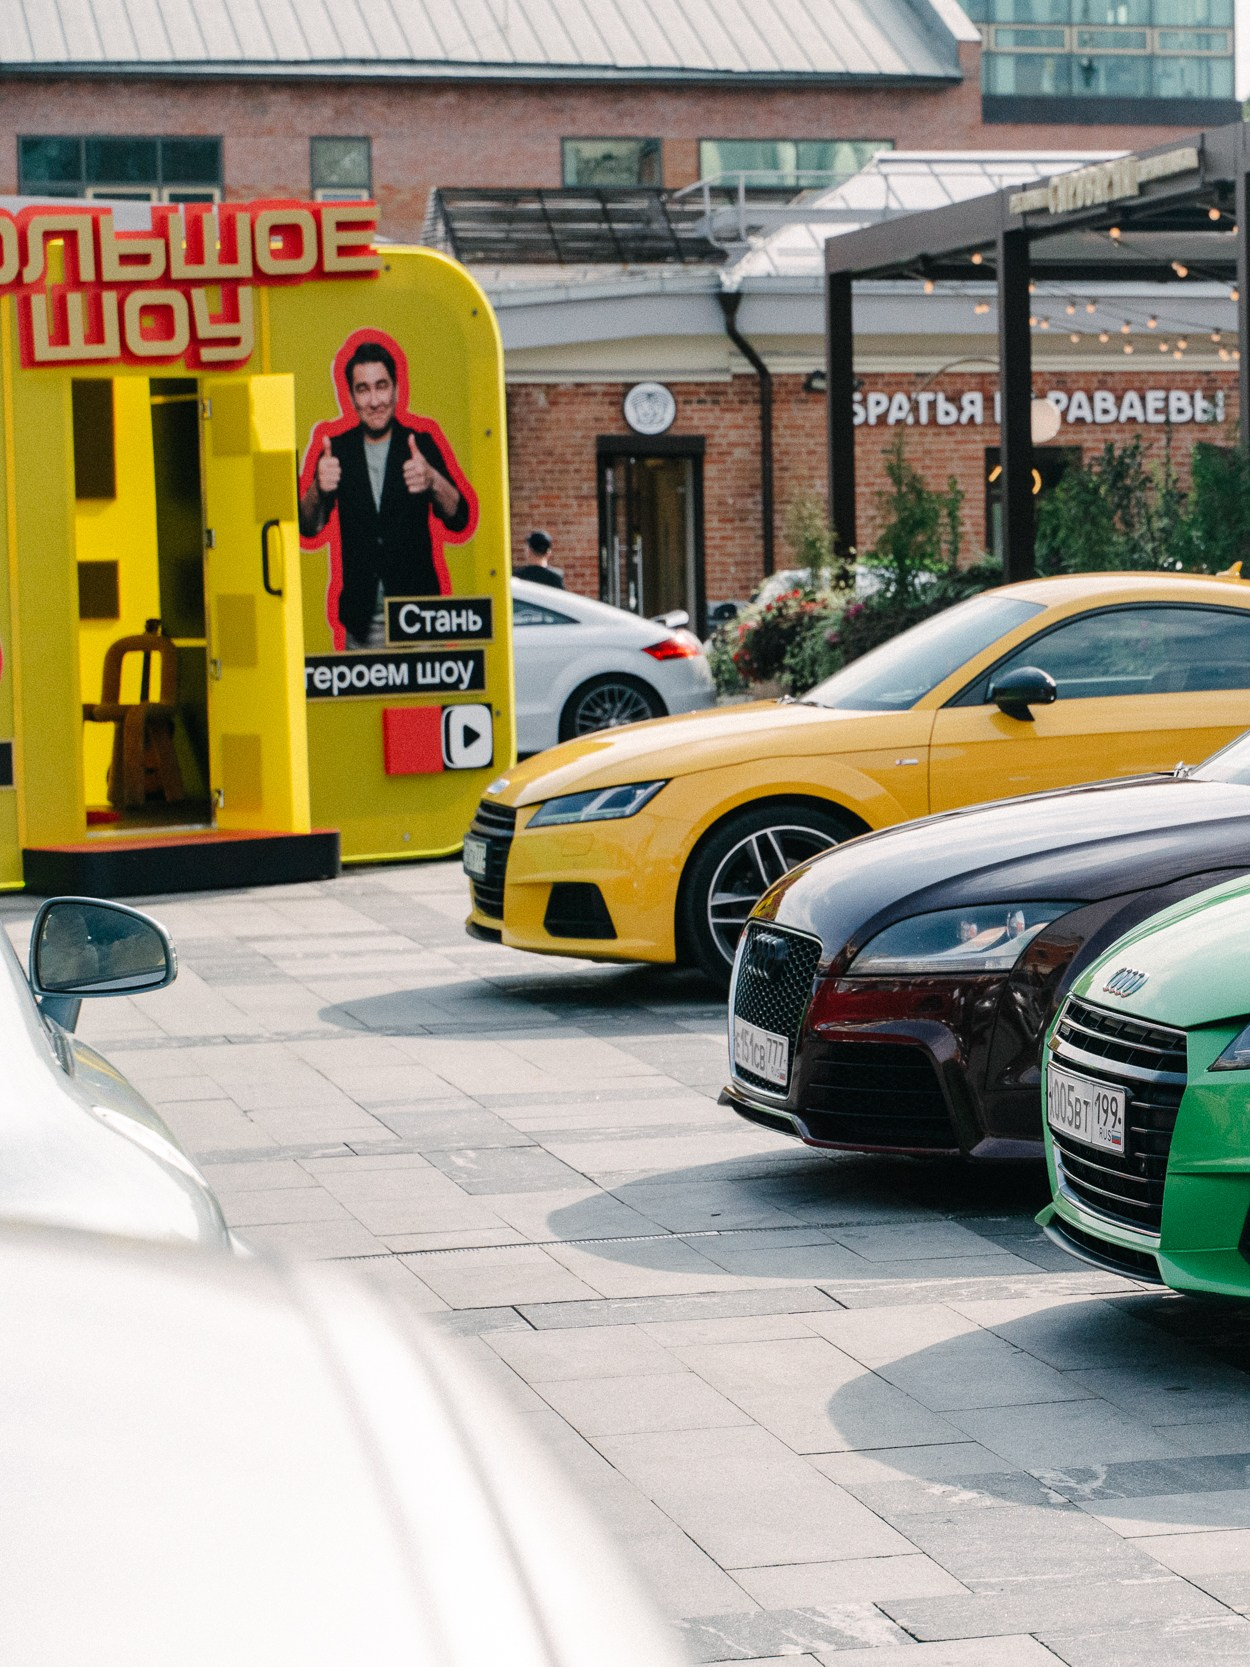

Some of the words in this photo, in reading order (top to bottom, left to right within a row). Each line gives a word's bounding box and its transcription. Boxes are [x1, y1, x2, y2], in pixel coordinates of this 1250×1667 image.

[30, 285, 254, 363] ШОУ
[399, 603, 483, 634] Стань
[416, 660, 475, 690] шоу
[767, 1037, 784, 1067] 777
[1094, 1092, 1118, 1129] 199
[1099, 1127, 1112, 1141] RUS
